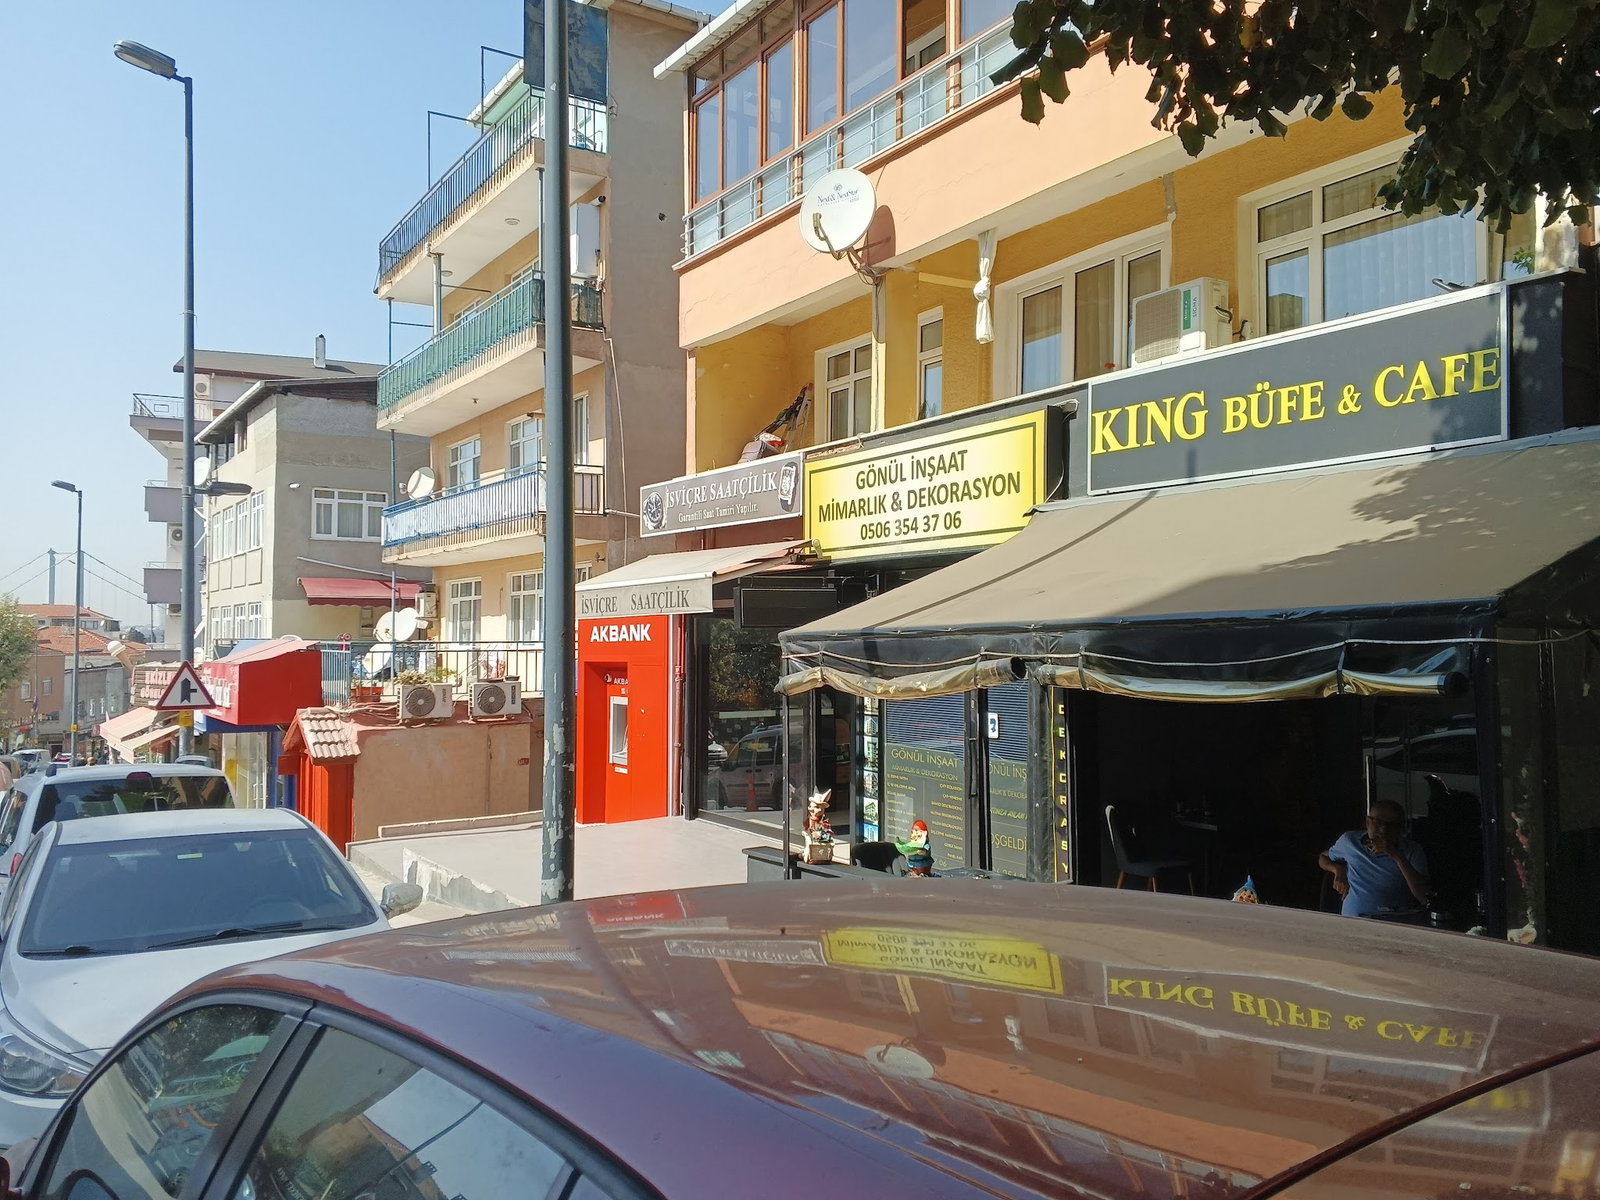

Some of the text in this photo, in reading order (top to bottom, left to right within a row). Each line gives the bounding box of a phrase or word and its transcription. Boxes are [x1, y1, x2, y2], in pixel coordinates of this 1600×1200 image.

[1091, 347, 1501, 456] KING BÜFE & CAFE
[855, 449, 968, 491] GÖNÜL İNŞAAT
[665, 468, 778, 509] İSVİÇRE SAATÇİLİK
[818, 470, 1021, 524] MİMARLIK & DEKORASYON
[703, 508, 715, 520] Saat
[860, 511, 962, 541] 0506 354 37 06
[580, 585, 690, 616] İSVİÇRE SAATÇİLİK
[590, 623, 651, 643] AKBANK
[891, 747, 960, 768] GÖNÜL İNŞAAT
